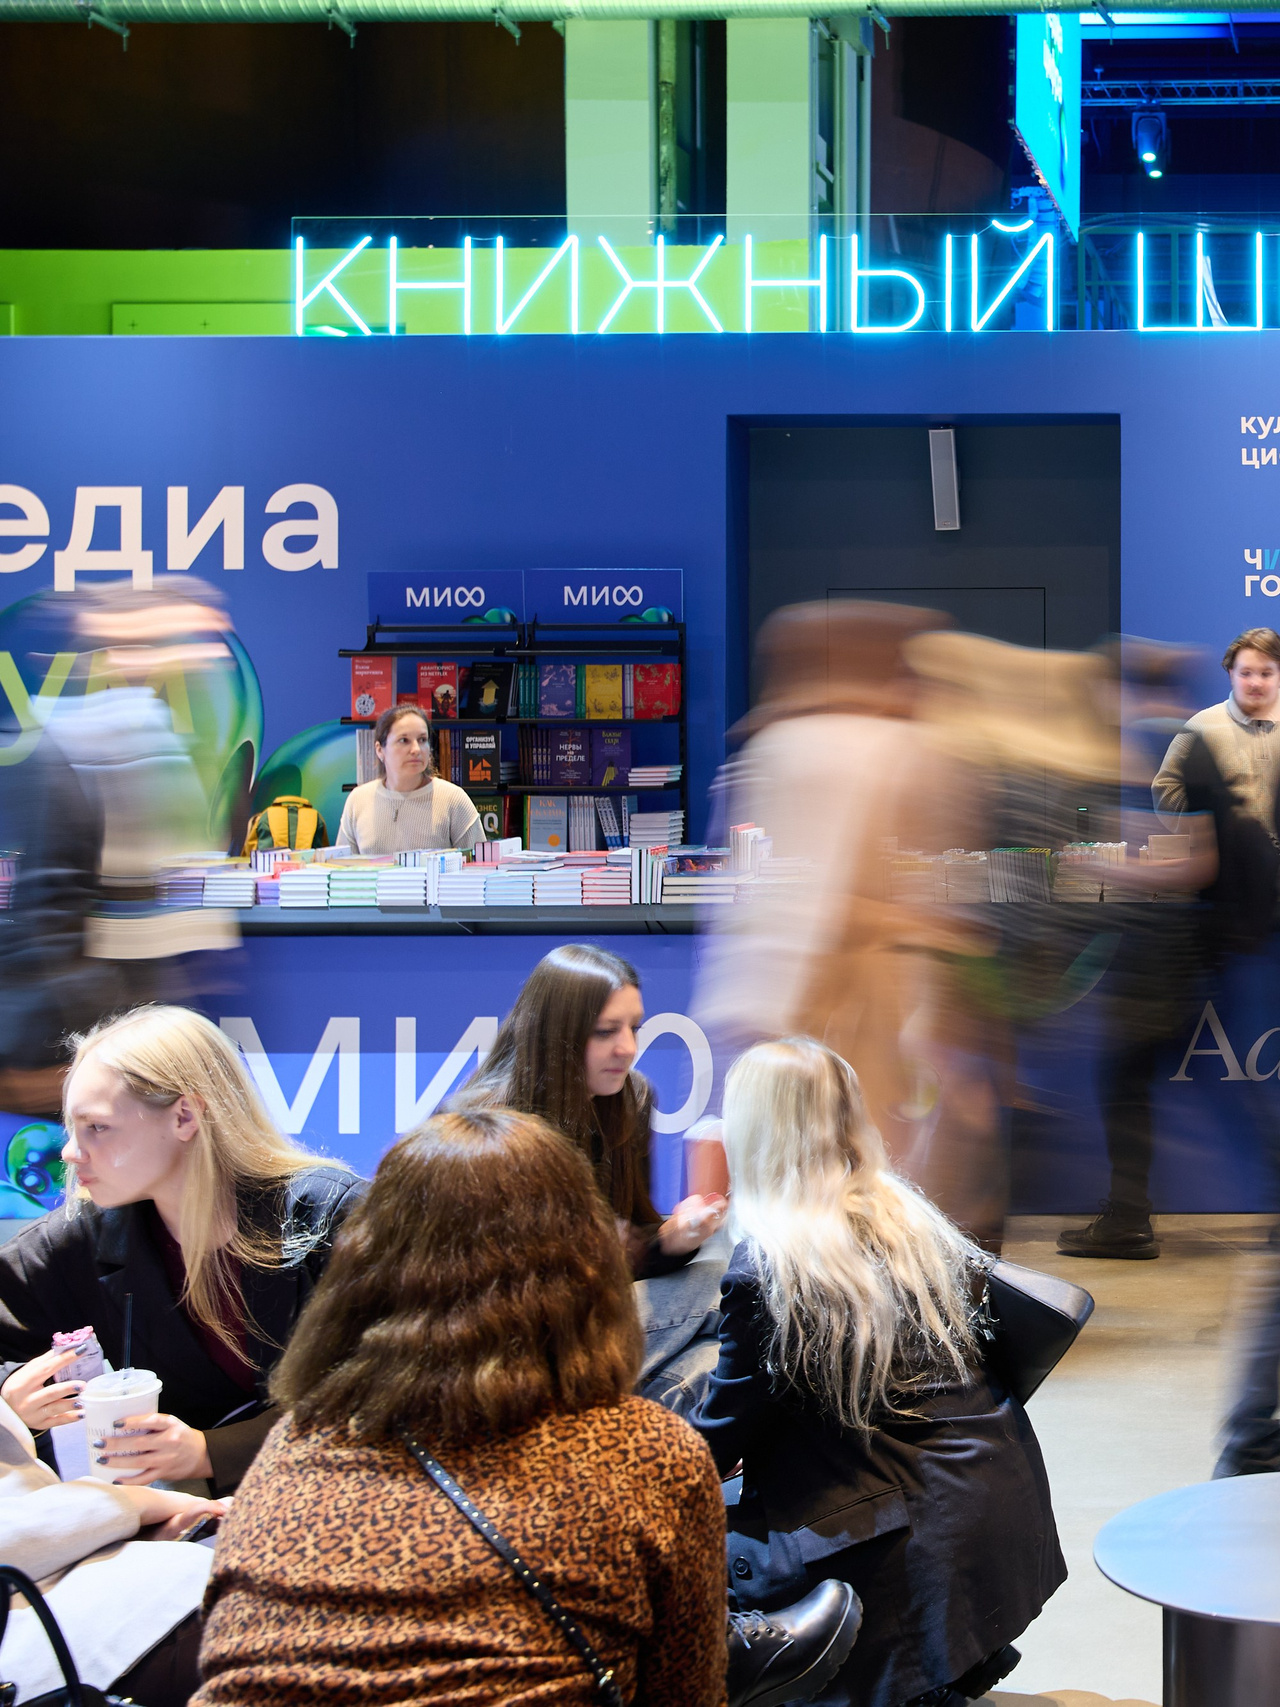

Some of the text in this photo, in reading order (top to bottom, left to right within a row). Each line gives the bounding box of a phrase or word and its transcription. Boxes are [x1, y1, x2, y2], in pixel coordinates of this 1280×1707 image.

[295, 219, 1055, 337] КНИЖНЫЙ
[465, 735, 495, 743] ОРГАНИЗУЙ
[539, 799, 557, 808] КАК
